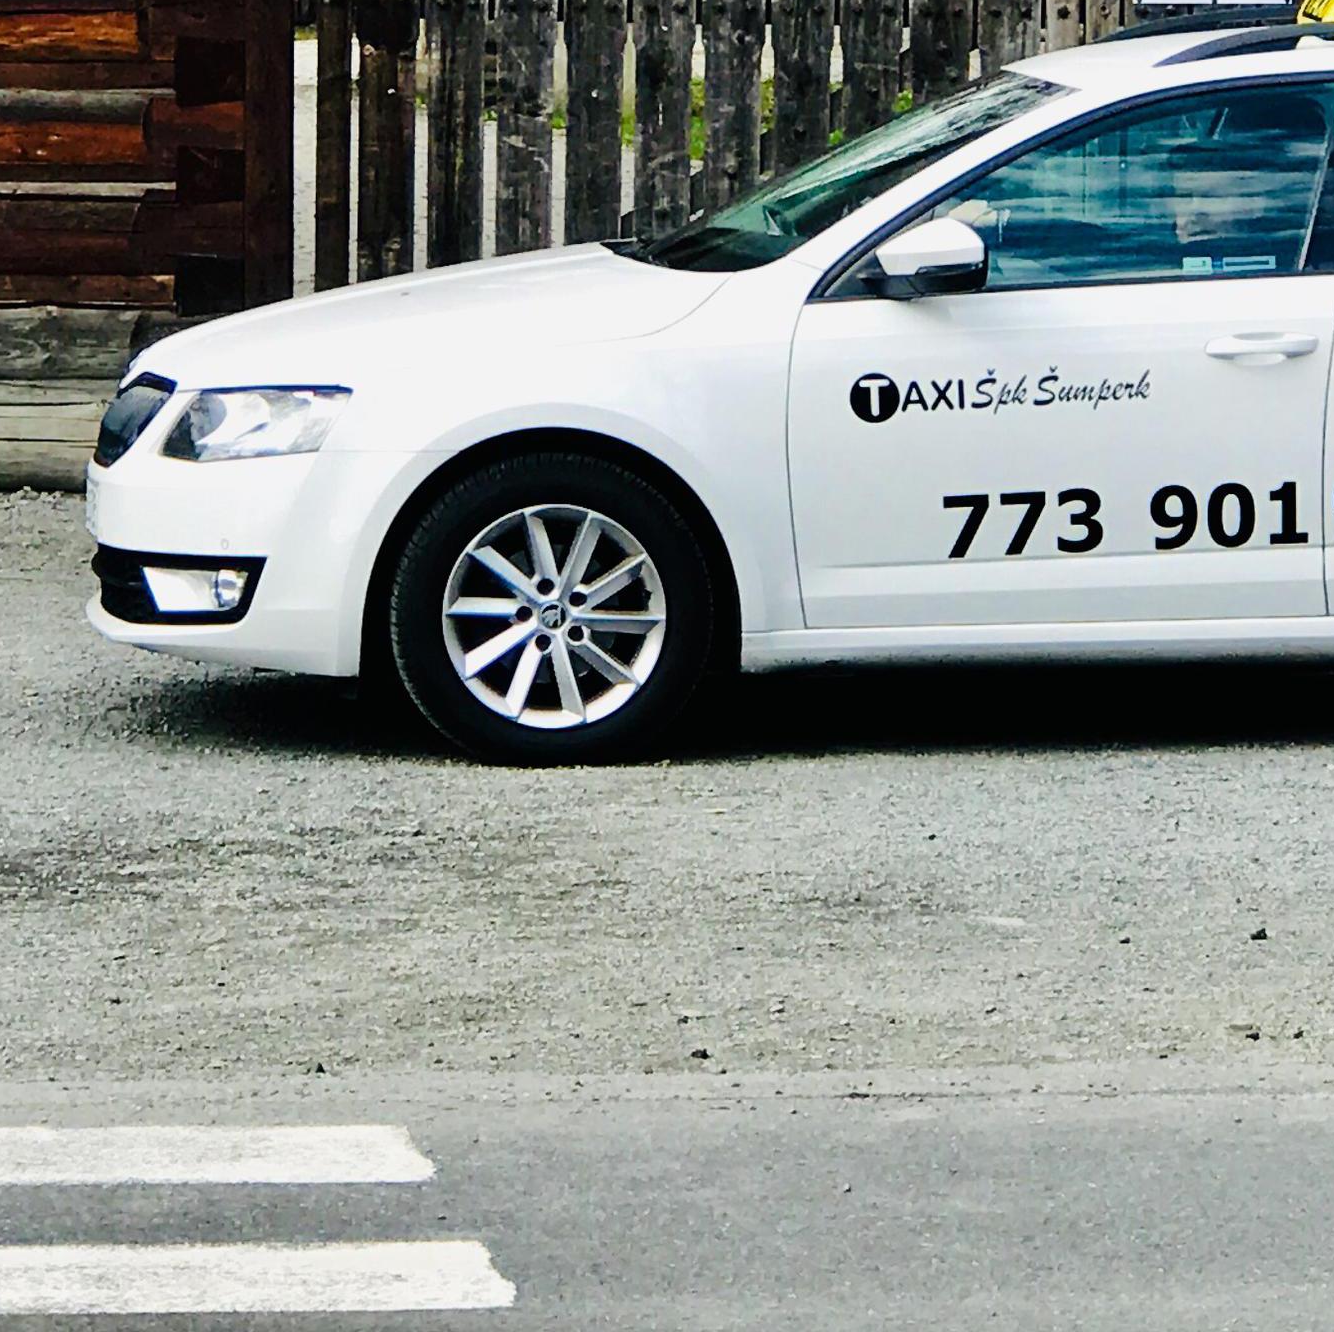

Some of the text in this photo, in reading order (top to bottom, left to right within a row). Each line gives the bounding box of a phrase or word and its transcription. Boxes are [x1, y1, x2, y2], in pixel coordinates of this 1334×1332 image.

[851, 372, 965, 423] TAXI
[1032, 365, 1151, 411] Šumperk
[941, 487, 1105, 559] 773
[1149, 481, 1310, 551] 901
